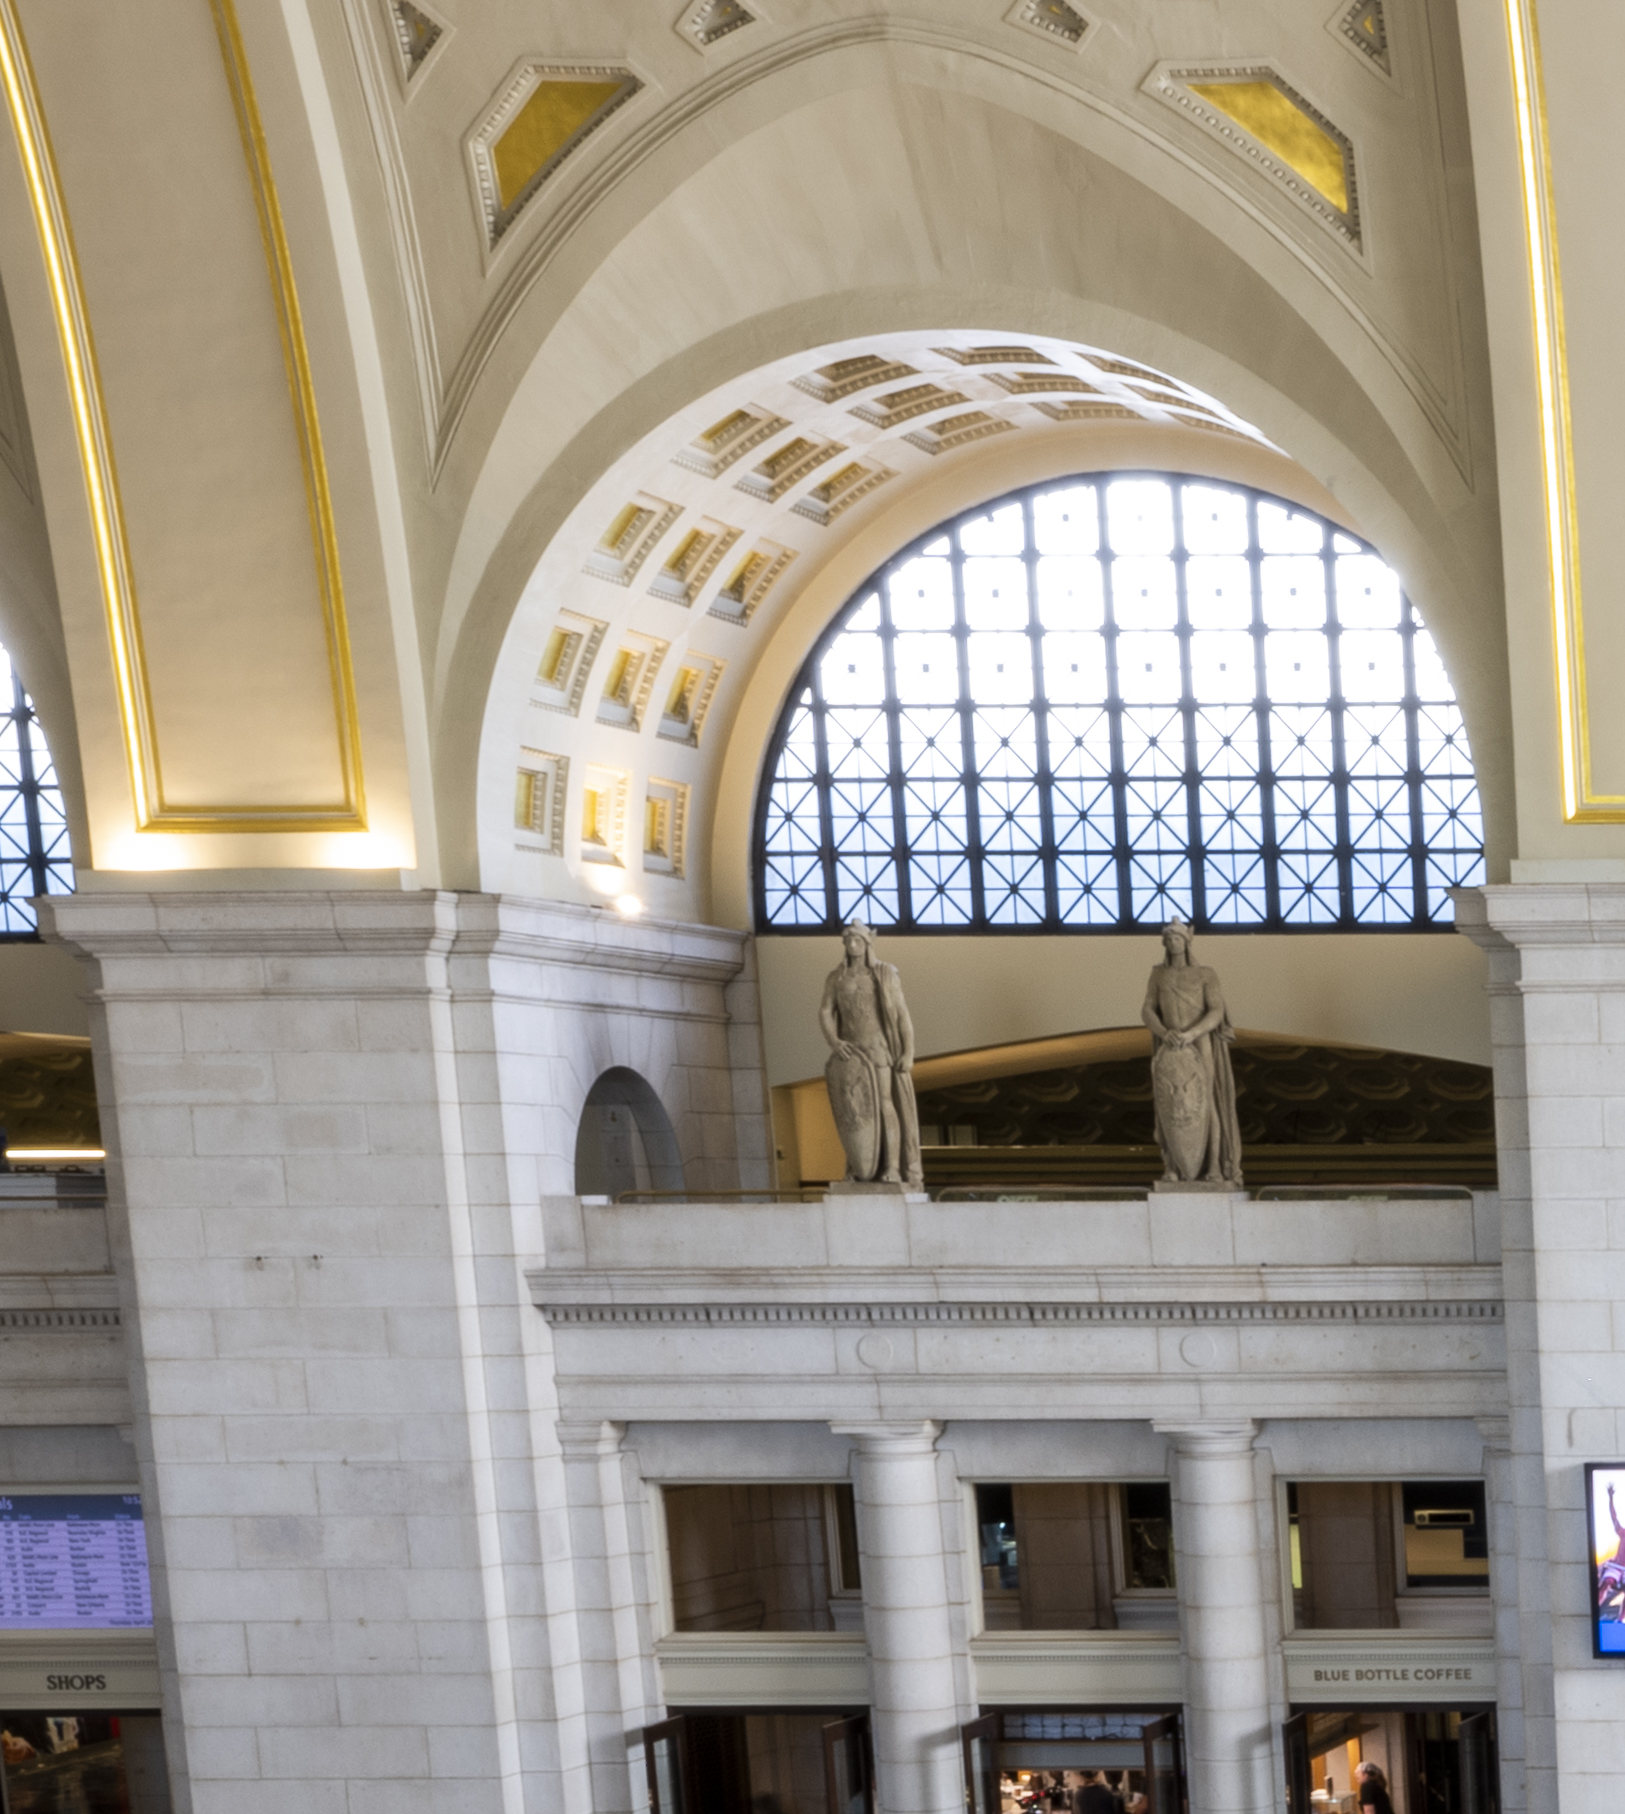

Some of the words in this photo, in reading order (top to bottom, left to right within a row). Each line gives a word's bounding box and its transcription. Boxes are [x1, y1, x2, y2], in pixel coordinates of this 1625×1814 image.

[46, 1673, 108, 1692] SHOPS
[1313, 1668, 1349, 1683] BLUE
[1354, 1668, 1410, 1683] BOTTLE
[1413, 1667, 1473, 1682] COFFEE
